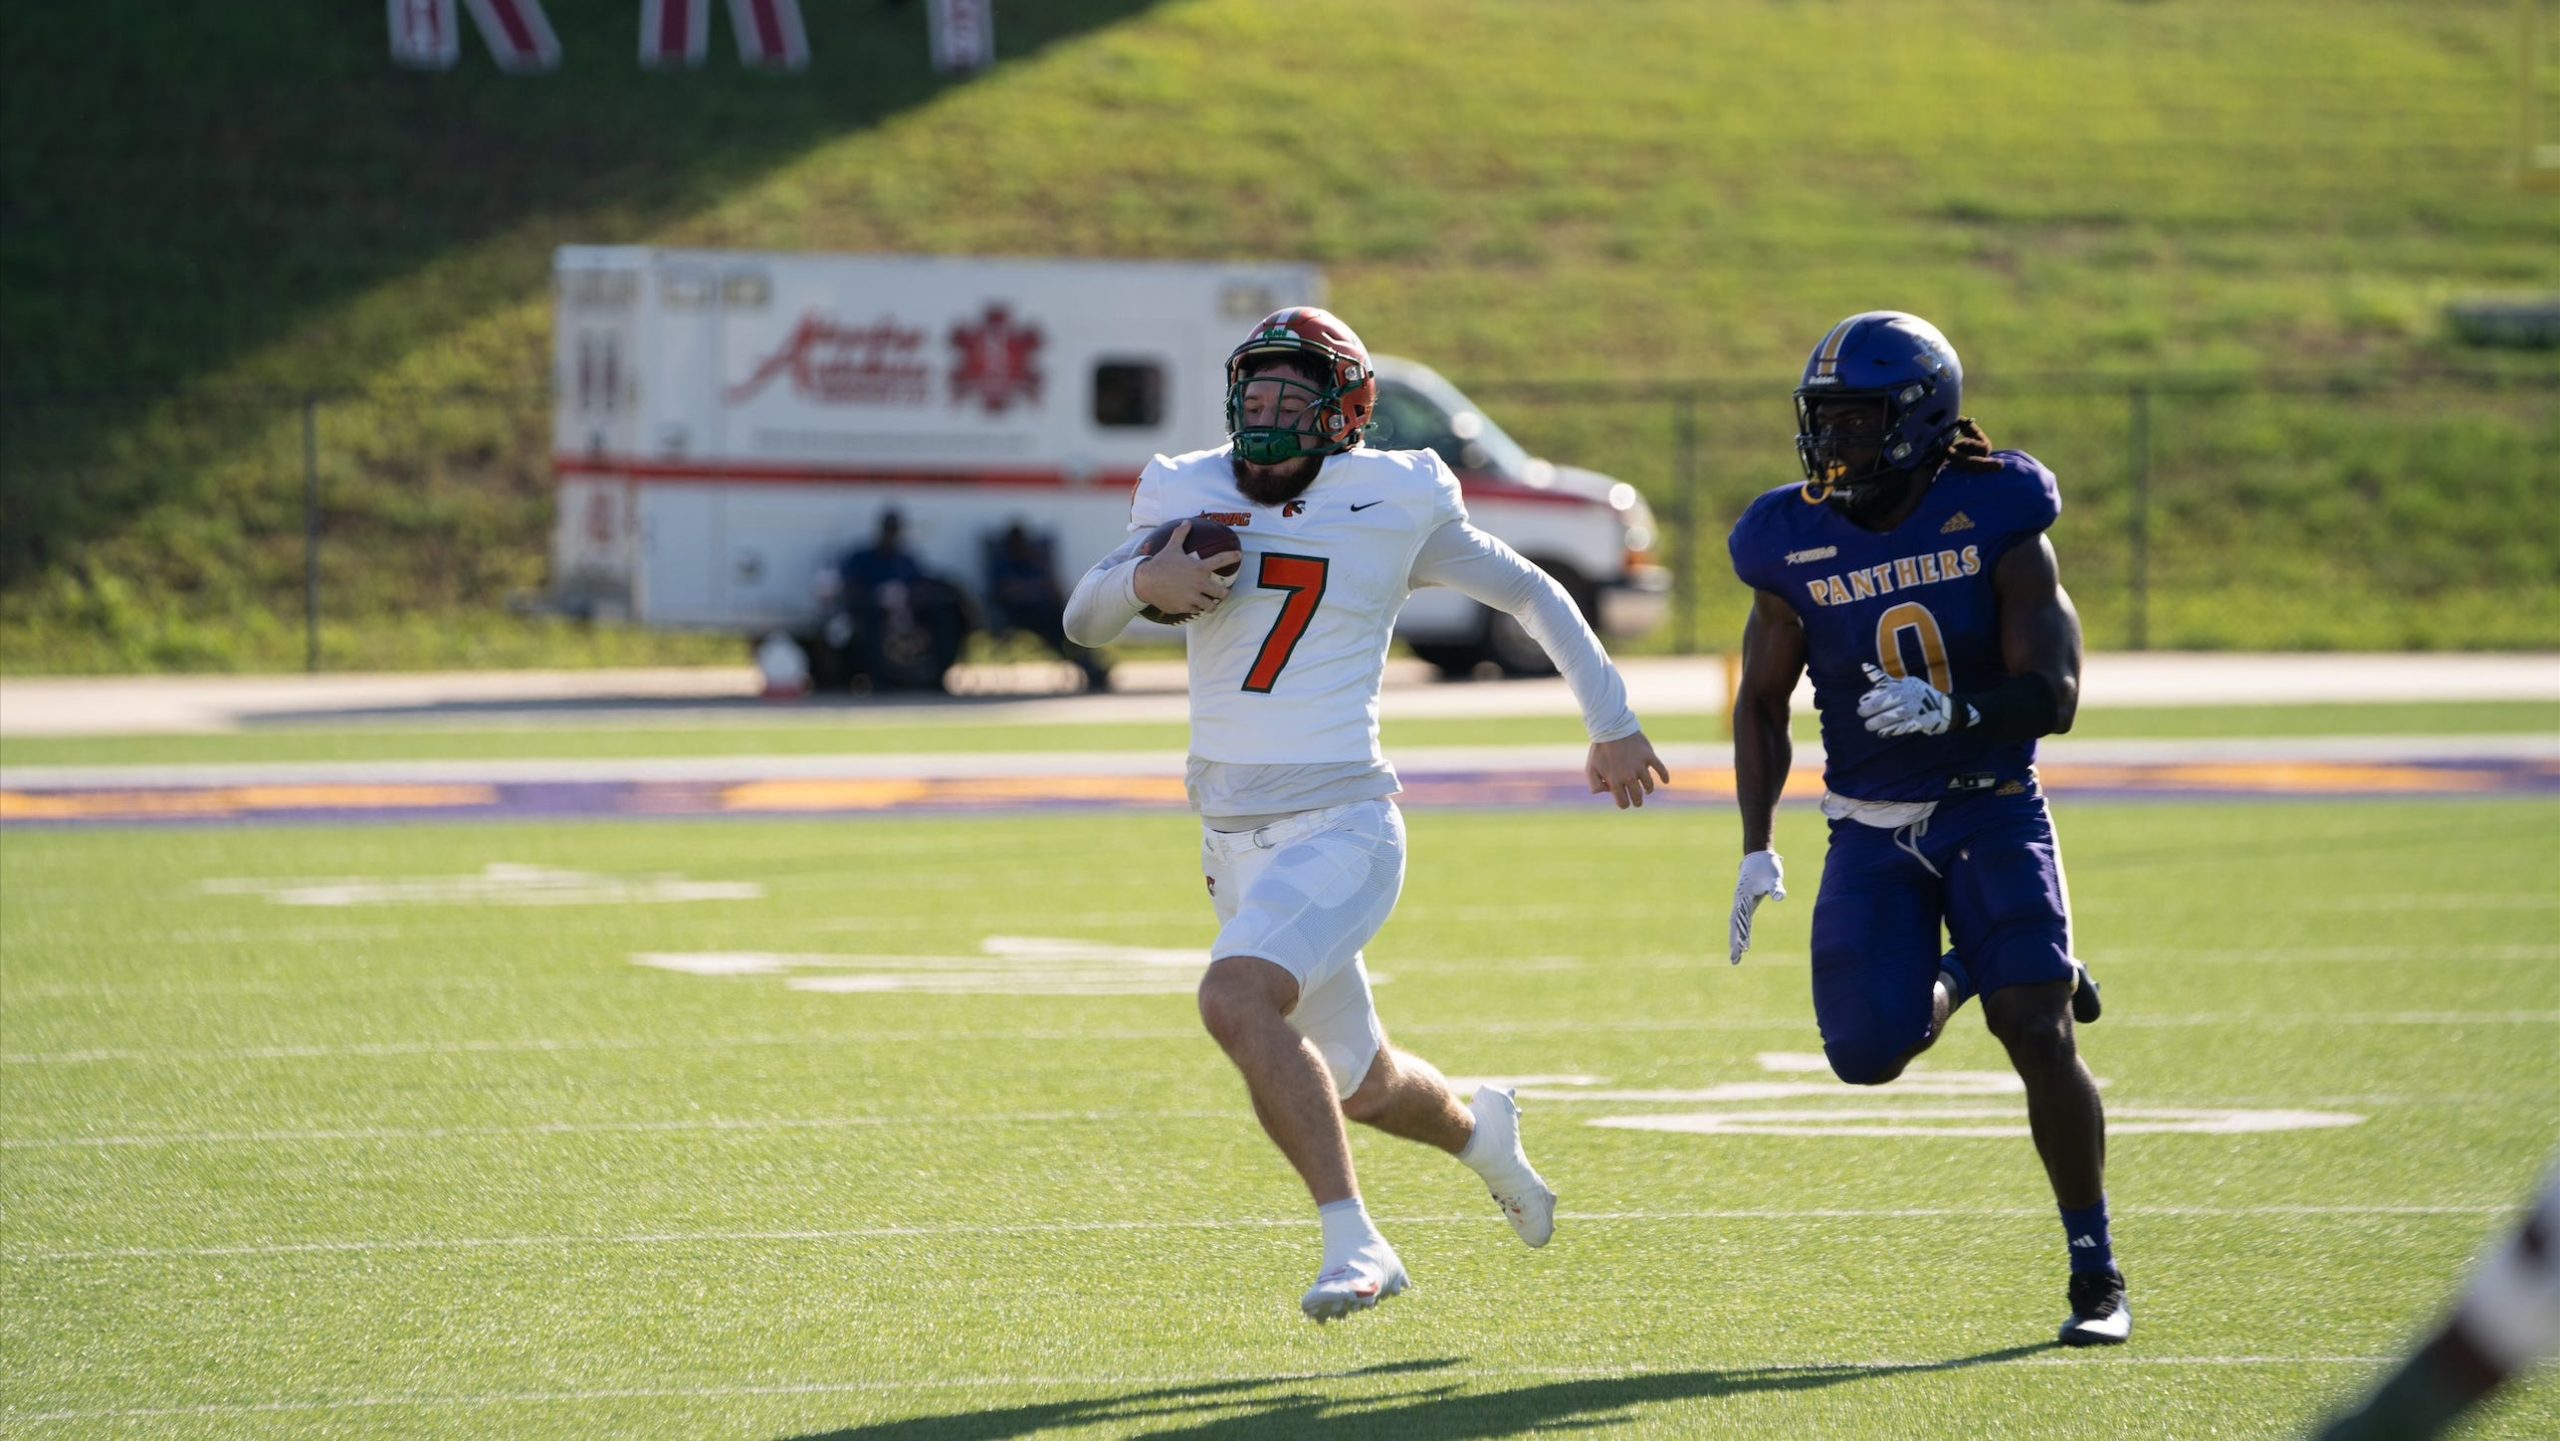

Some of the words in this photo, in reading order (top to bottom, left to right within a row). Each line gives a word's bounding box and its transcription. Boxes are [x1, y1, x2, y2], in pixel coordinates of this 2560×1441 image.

[1806, 545, 1982, 607] PANTHERS
[1240, 551, 1330, 695] 7
[1876, 601, 1953, 694] 0
